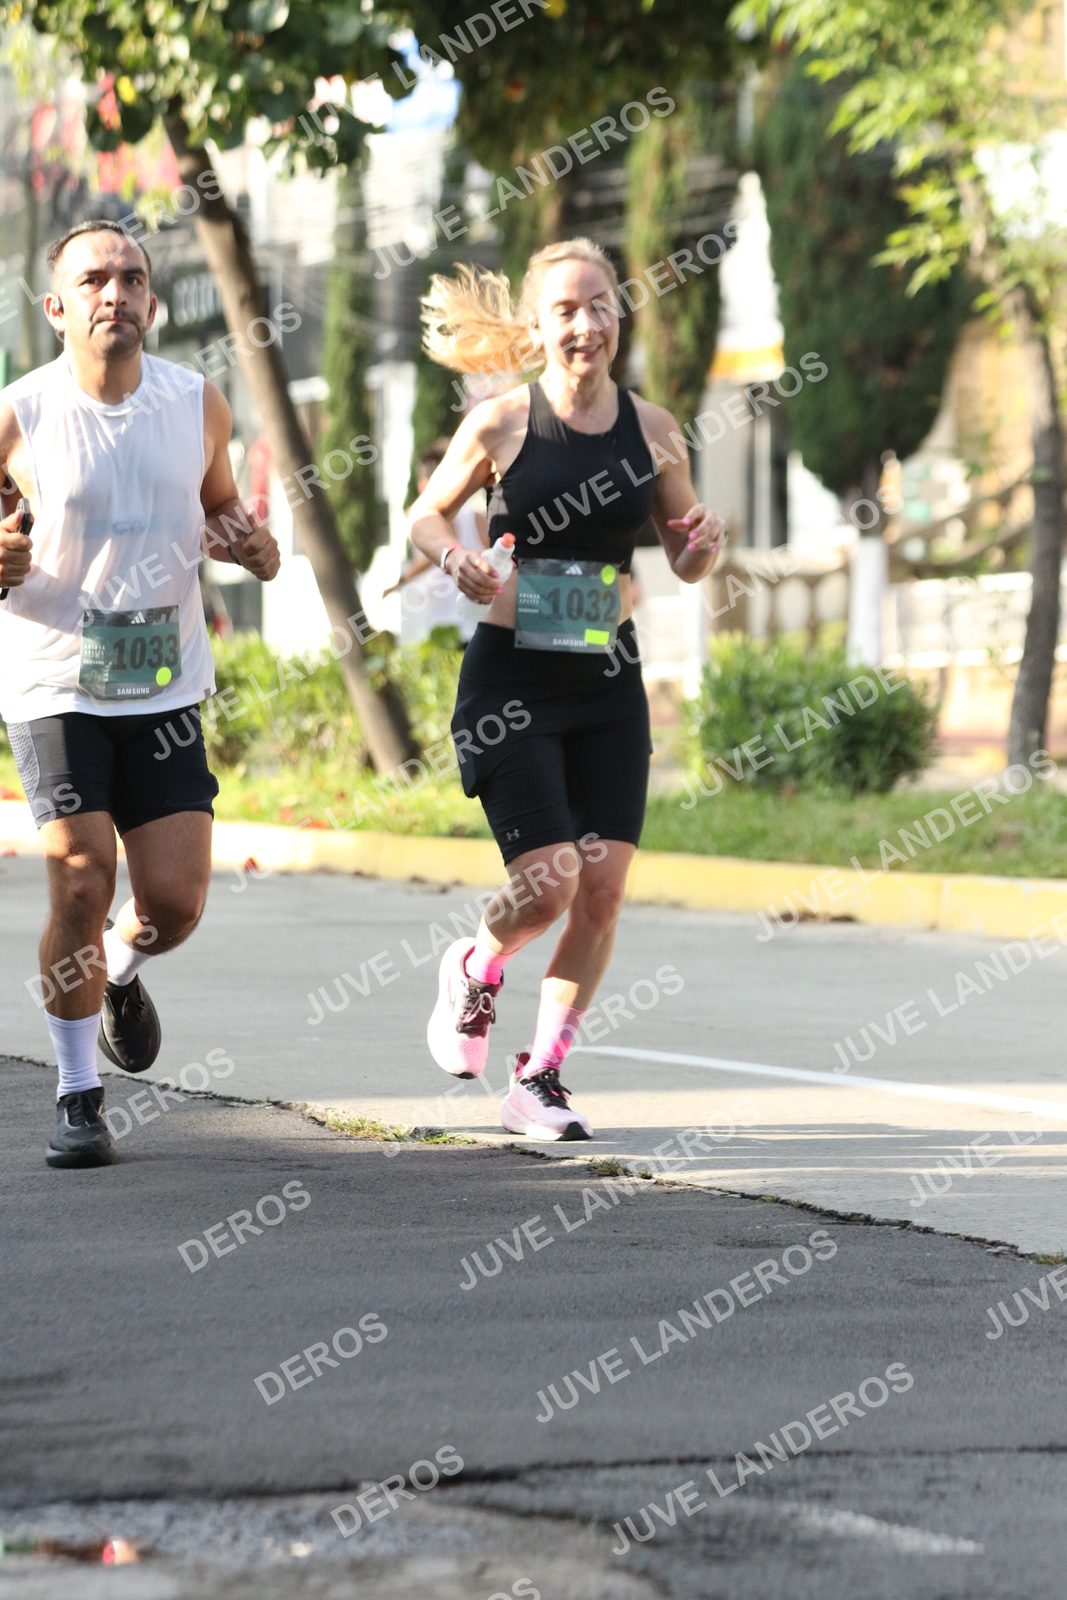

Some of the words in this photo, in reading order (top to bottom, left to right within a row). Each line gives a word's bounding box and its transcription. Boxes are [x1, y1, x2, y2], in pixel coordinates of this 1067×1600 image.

[547, 586, 617, 623] 1032
[112, 634, 179, 670] 1033
[116, 687, 150, 696] SAMSUNG
